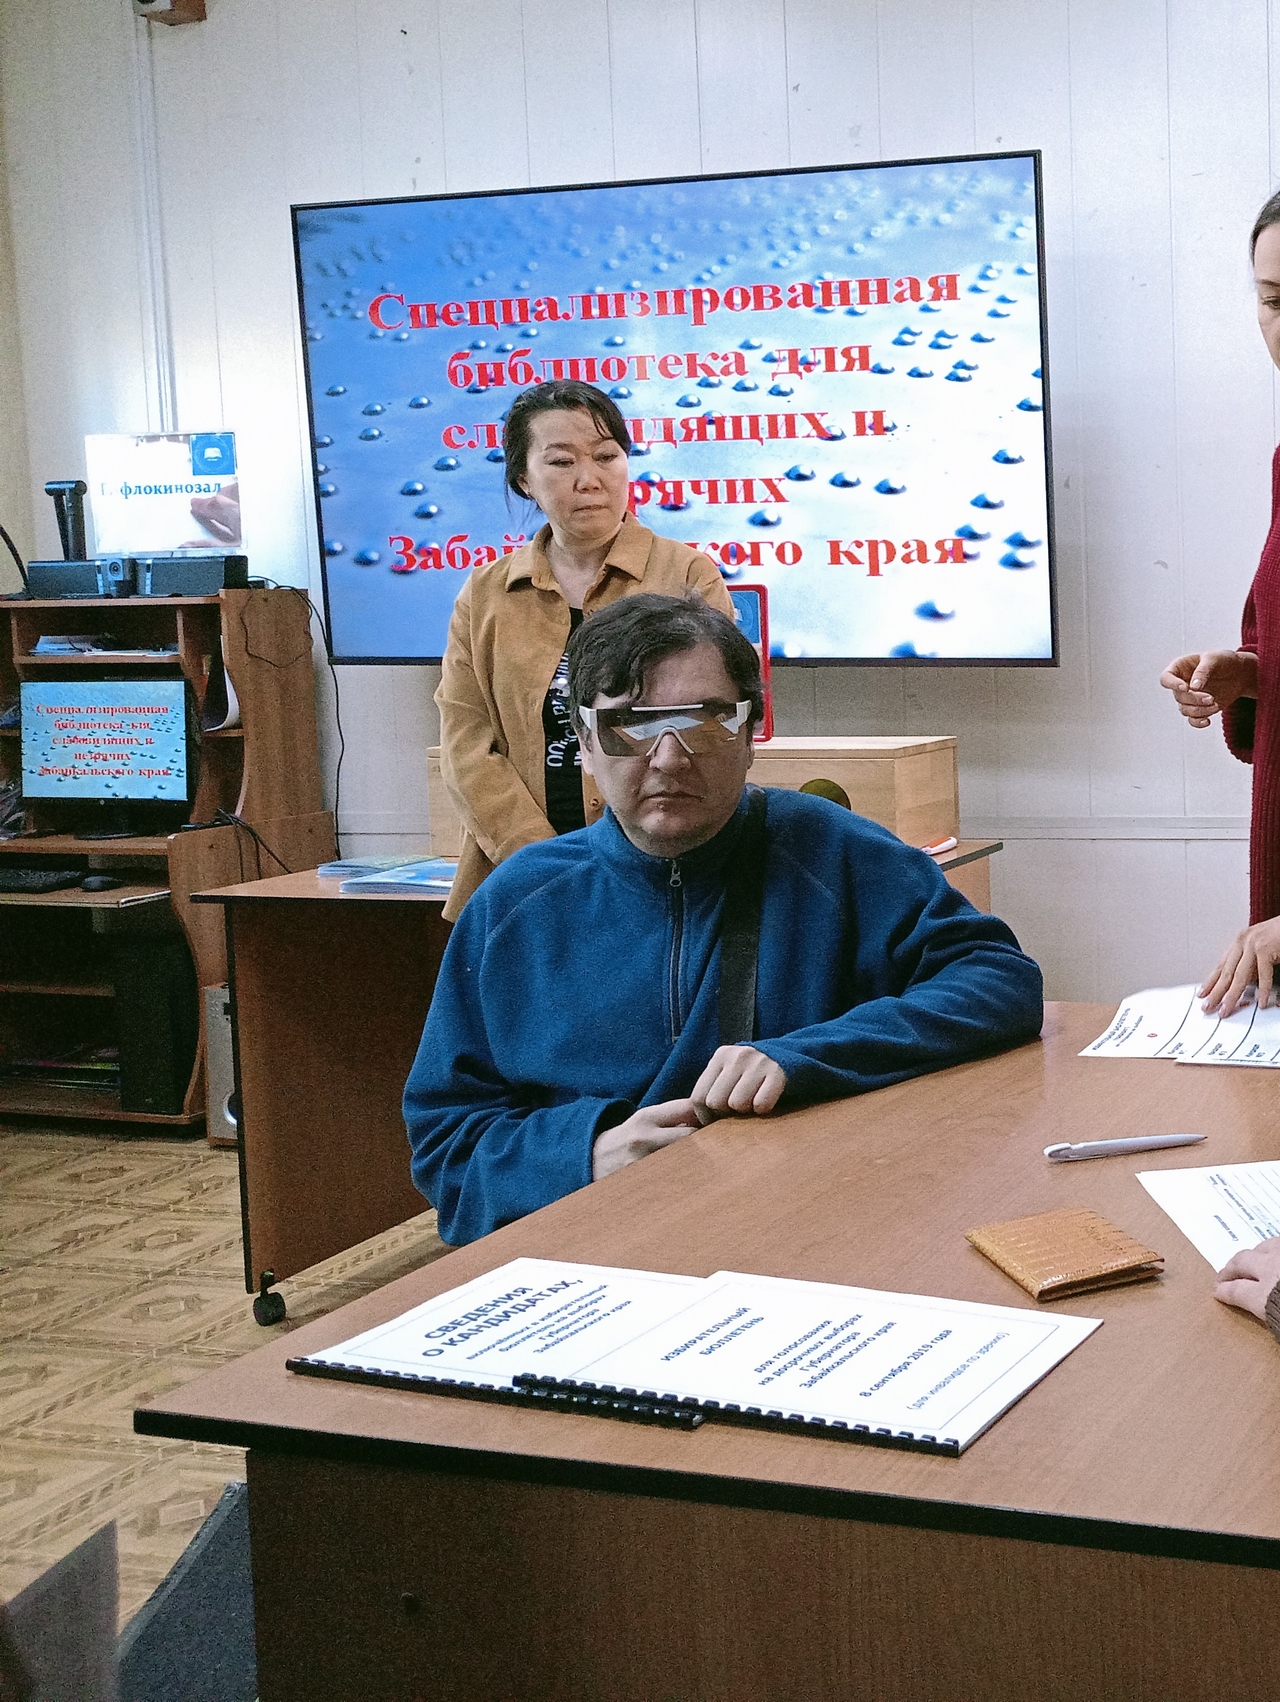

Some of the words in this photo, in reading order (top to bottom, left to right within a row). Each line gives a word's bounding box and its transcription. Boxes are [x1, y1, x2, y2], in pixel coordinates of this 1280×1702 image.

[367, 269, 960, 333] Специализированная
[447, 343, 746, 392] библиотека
[771, 344, 873, 384] для
[442, 409, 830, 450] слидящих
[853, 409, 888, 437] и
[101, 481, 222, 499] флокинозал
[827, 535, 967, 577] края
[422, 1347, 445, 1358] О
[442, 1278, 584, 1347] КАНДИДАТАХ,
[424, 1286, 533, 1339] СВЕДЕНИЯ
[660, 1306, 752, 1362] ИЗБИРАТЕЛЬНЫЙ
[699, 1316, 765, 1356] БЮЛЛЕТЕНЬ
[754, 1359, 775, 1374] для
[773, 1319, 832, 1360] голосования
[758, 1375, 774, 1386] на
[772, 1340, 826, 1378] досрочных
[823, 1313, 864, 1341] выборах
[799, 1331, 861, 1372] Губернатора
[799, 1335, 876, 1388] Забайкальского
[873, 1321, 897, 1337] края
[869, 1360, 913, 1392] сентября
[907, 1344, 933, 1361] 2019
[930, 1328, 953, 1344] года
